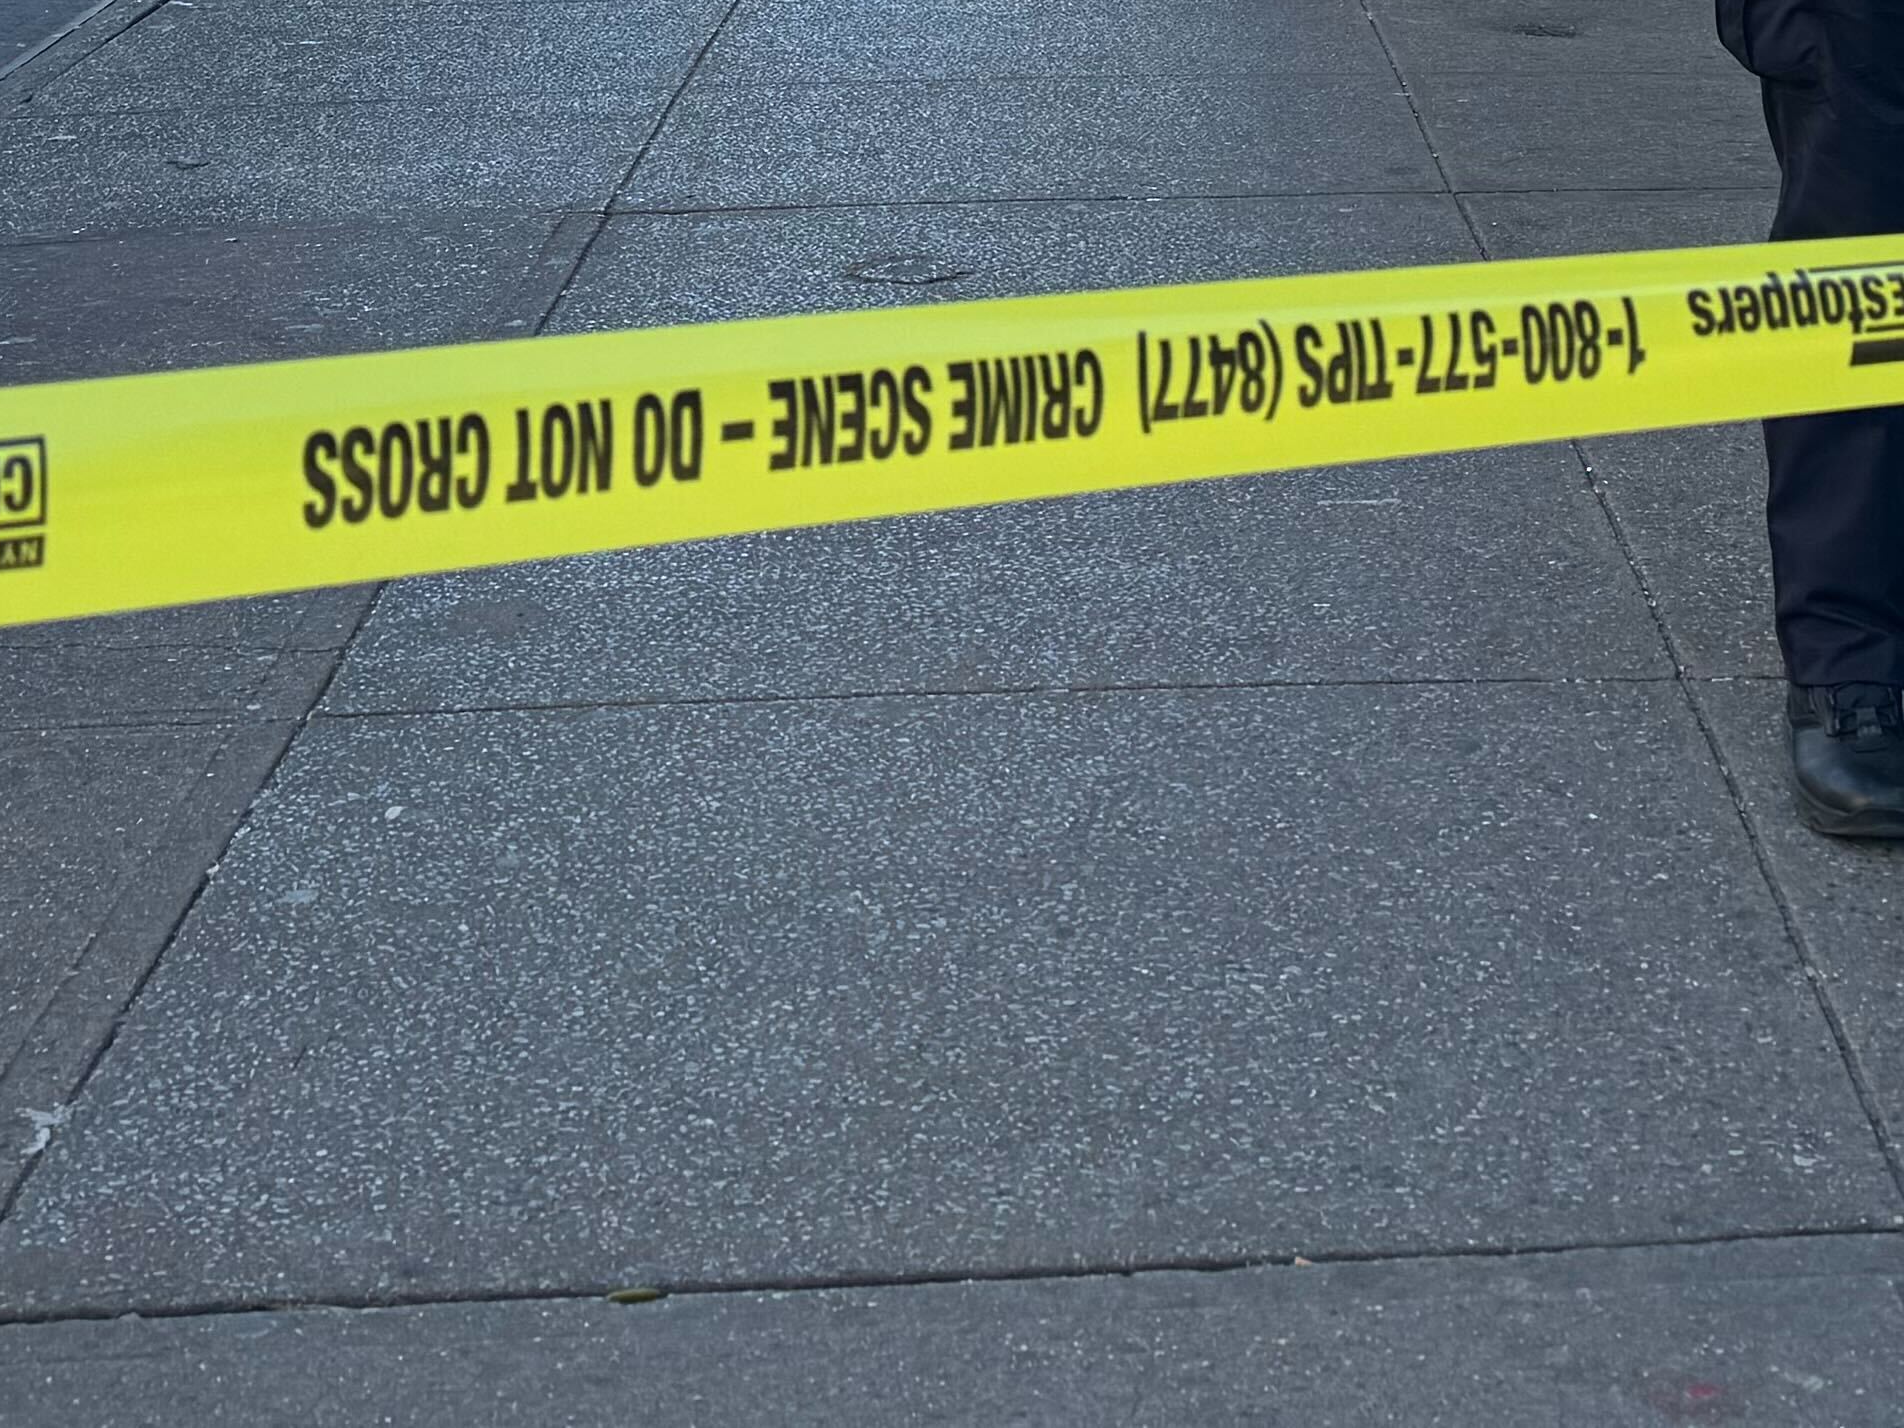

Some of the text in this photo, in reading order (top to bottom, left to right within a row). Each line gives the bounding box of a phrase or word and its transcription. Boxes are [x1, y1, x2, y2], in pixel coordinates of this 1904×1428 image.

[947, 346, 1104, 450] CRIME
[1137, 318, 1284, 434] (8477)
[1297, 294, 1647, 410] 1-800-577-TIPS
[302, 410, 491, 530] CROSS
[504, 398, 614, 504] NOT
[633, 388, 704, 488] DO
[768, 364, 934, 472] SCENE
